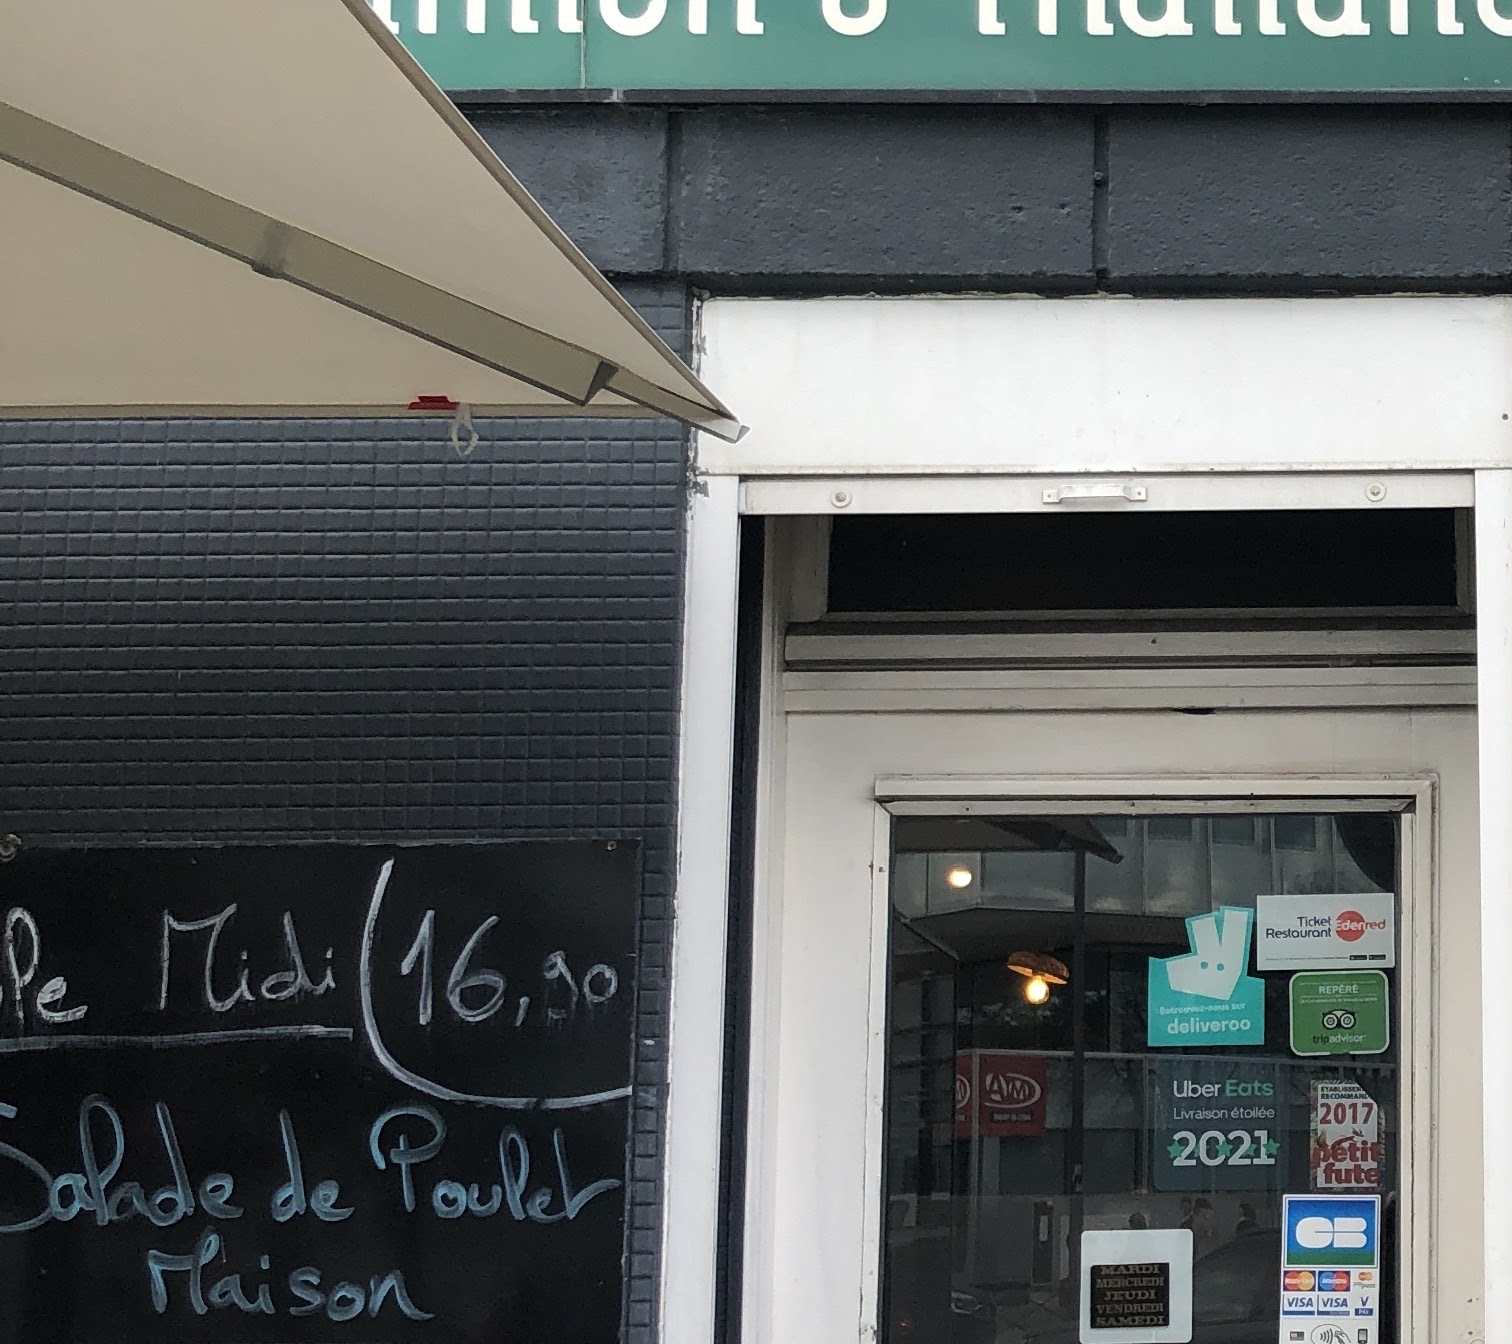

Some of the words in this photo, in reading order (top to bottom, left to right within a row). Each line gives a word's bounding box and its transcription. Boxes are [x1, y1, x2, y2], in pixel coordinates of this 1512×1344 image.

[1297, 915, 1332, 928] Ticket
[1335, 918, 1386, 932] Edenred
[1265, 927, 1332, 939] Restaurant
[159, 903, 336, 1012] Midi
[1167, 1017, 1251, 1035] deliveroo
[1312, 1033, 1365, 1045] tripadvisor
[1173, 1079, 1222, 1098] Uber
[1225, 1079, 1275, 1097] Eats
[1173, 1107, 1228, 1120] Livraison
[1230, 1106, 1276, 1119] étoilée
[1319, 1102, 1374, 1125] 2017
[1172, 1129, 1276, 1167] 2021
[271, 1108, 356, 1223] de
[369, 1102, 622, 1223] Poulet
[148, 1226, 436, 1321] Maison
[1100, 1264, 1160, 1275] MARDI
[1096, 1276, 1165, 1288] MERCREDI
[1104, 1289, 1157, 1301] JEUDI
[1096, 1303, 1164, 1314] VENDREDI
[1287, 1297, 1314, 1308] VISA
[1321, 1297, 1349, 1308] VISA
[1096, 1316, 1165, 1327] SAMEDI
